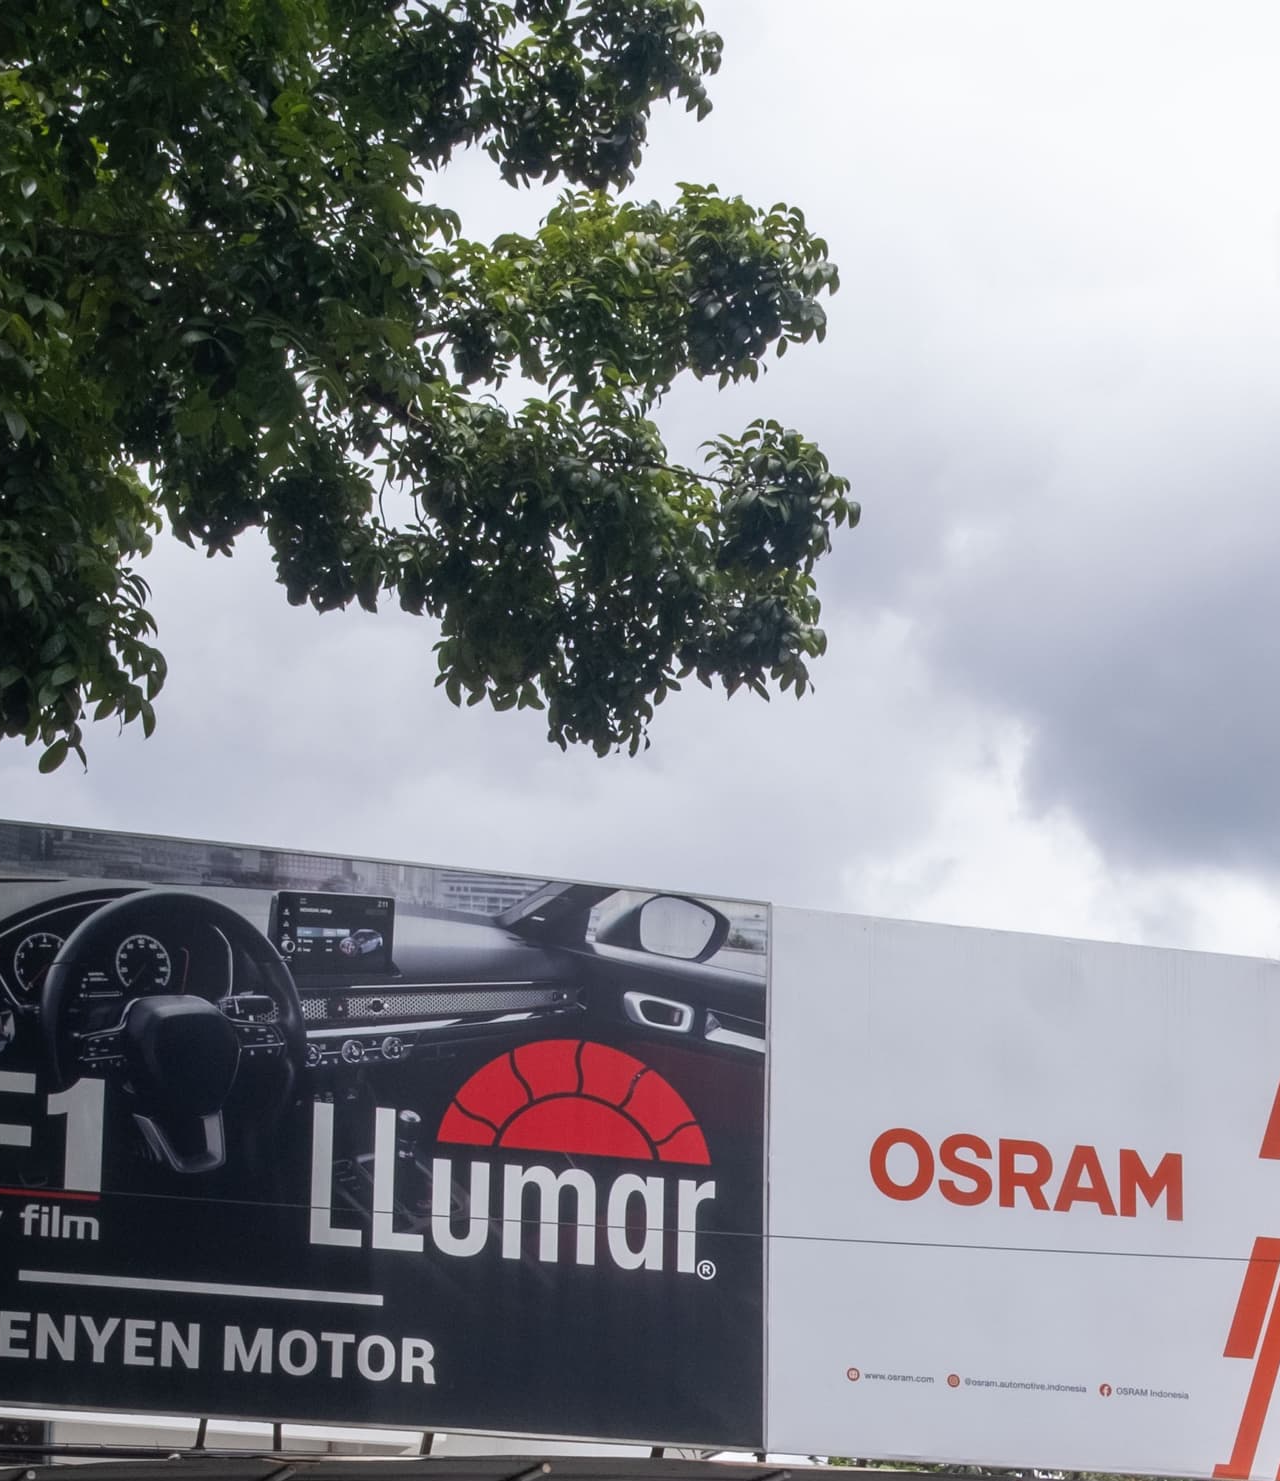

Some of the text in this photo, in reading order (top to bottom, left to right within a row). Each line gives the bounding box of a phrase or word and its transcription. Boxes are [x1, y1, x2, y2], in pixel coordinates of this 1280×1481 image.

[309, 1100, 715, 1272] LLumar
[869, 1127, 1184, 1221] OSRAM
[19, 1202, 101, 1242] film
[221, 1326, 438, 1387] MOTOR
[1116, 1386, 1148, 1397] OSRAM
